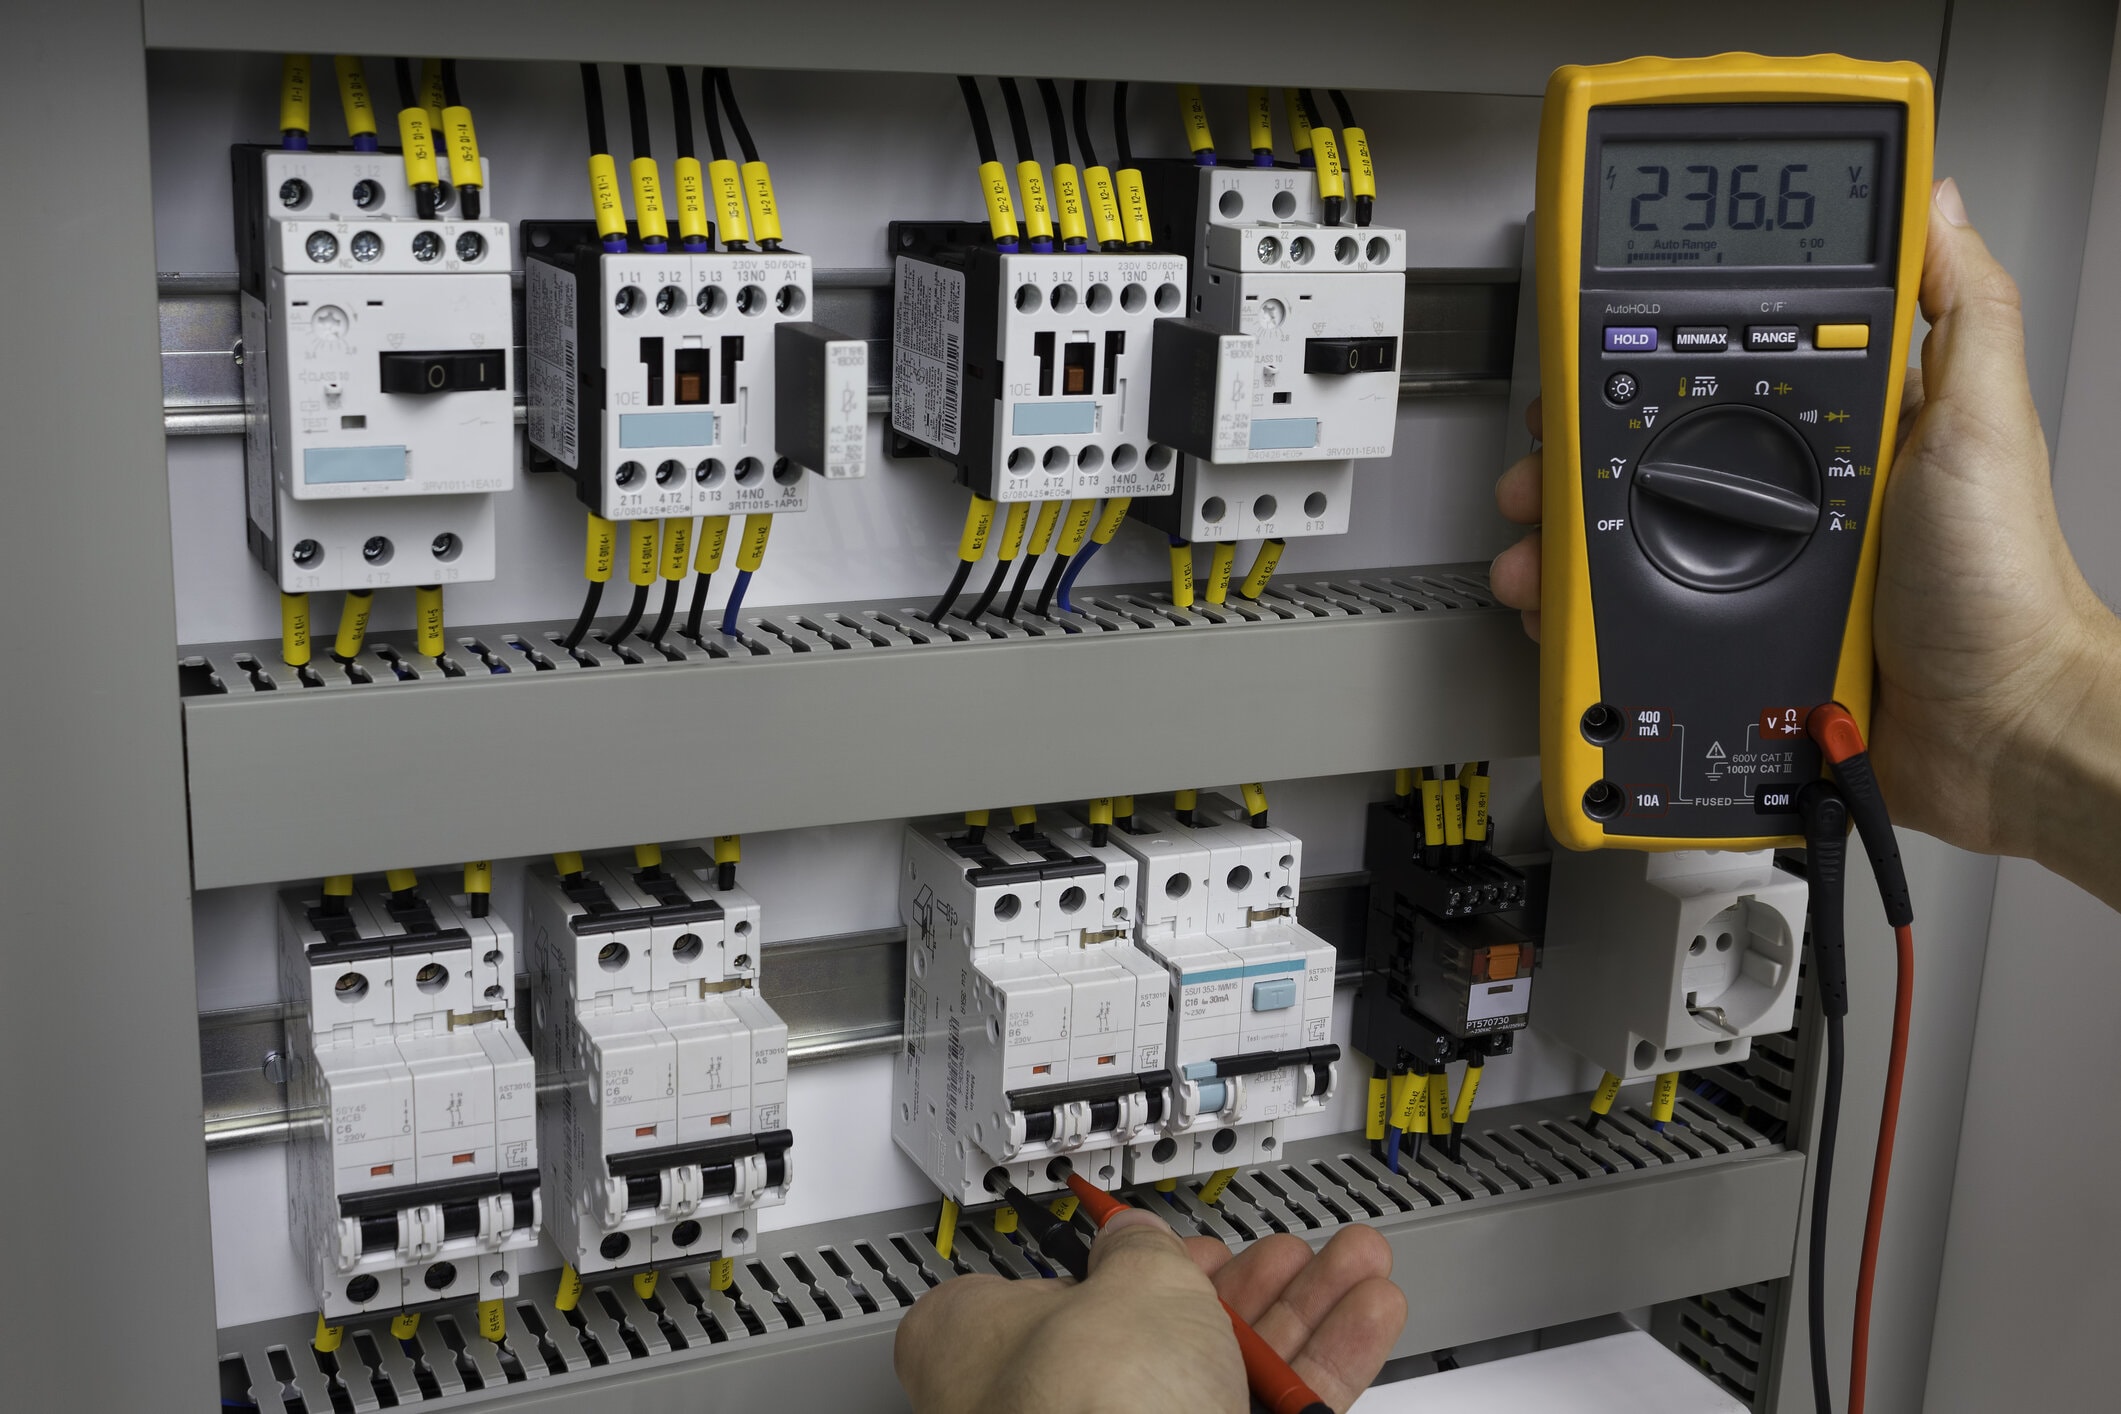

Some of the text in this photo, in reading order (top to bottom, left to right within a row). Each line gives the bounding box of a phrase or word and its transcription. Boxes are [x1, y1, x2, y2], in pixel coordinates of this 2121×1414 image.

[1849, 166, 1863, 183] V
[1231, 179, 1240, 189] L1
[1274, 178, 1294, 189] 3 L2
[1849, 185, 1868, 198] AC
[1629, 164, 1815, 231] 236.6
[1244, 230, 1253, 239] 21
[1280, 230, 1289, 240] 22
[1358, 232, 1367, 242] 13
[1394, 233, 1402, 242] 14
[1653, 239, 1680, 250] Auto
[1681, 238, 1718, 251] Range
[732, 261, 807, 270] 230V 50/60Hz
[1118, 262, 1141, 271] 230V
[1280, 260, 1291, 270] NC
[1357, 262, 1369, 272] NO
[619, 271, 641, 282] 1 L1
[658, 271, 682, 282] 3 L2
[699, 271, 722, 282] 5 L3
[784, 270, 797, 281] A1
[1017, 271, 1038, 282] 1 L1
[1052, 271, 1073, 282] 3 L2
[1088, 271, 1109, 282] 5 L3
[1164, 270, 1176, 281] A1
[1605, 303, 1661, 314] AutoHOLD
[1311, 322, 1327, 331] OFF
[1373, 321, 1384, 330] ON
[1613, 333, 1649, 345] HOLD
[1676, 333, 1727, 345] MINMAX
[1751, 331, 1796, 344] RANGE
[1275, 354, 1283, 363] 10
[1009, 383, 1032, 396] 10E
[1692, 383, 1719, 397] mV
[1629, 414, 1656, 430] Hz V
[1326, 446, 1386, 457] 3RV1011-1EA10
[1597, 465, 1623, 479] Hz V
[1828, 464, 1872, 477] mA Hz
[1043, 477, 1064, 488] 4 T2
[1079, 475, 1100, 486] 6 T3
[1153, 472, 1166, 484] A2
[1009, 478, 1029, 490] 2 T1
[1104, 483, 1172, 495] 3RT1015-1AP01
[699, 490, 722, 502] 6 T3
[782, 486, 796, 498] A2
[620, 494, 643, 506] 2 T1
[658, 492, 682, 504] 4 T2
[728, 498, 803, 511] 3RT1015-1AP01
[1255, 523, 1274, 534] 4 T2
[1306, 520, 1324, 531] 6 T3
[1597, 519, 1624, 532] OFF
[1829, 517, 1857, 530] A Hz
[1213, 525, 1223, 536] T1
[1637, 711, 1661, 723] 400
[1767, 717, 1777, 729] V
[1638, 725, 1659, 736] mA
[1732, 753, 1758, 763] 600V
[1760, 753, 1782, 762] CAT
[1726, 765, 1756, 774] 1000V
[1759, 764, 1781, 774] CAT
[1636, 794, 1660, 807] 10A
[1695, 797, 1733, 807] FUSED
[1763, 794, 1789, 806] COM
[1187, 912, 1225, 929] 1 N
[1140, 1000, 1151, 1008] AS
[1184, 994, 1230, 1007] C16 30mA
[1466, 1016, 1510, 1030] PT570730
[1008, 1028, 1021, 1037] B6
[500, 1092, 513, 1100] AS
[606, 1087, 620, 1097] C6
[336, 1125, 353, 1135] C6
